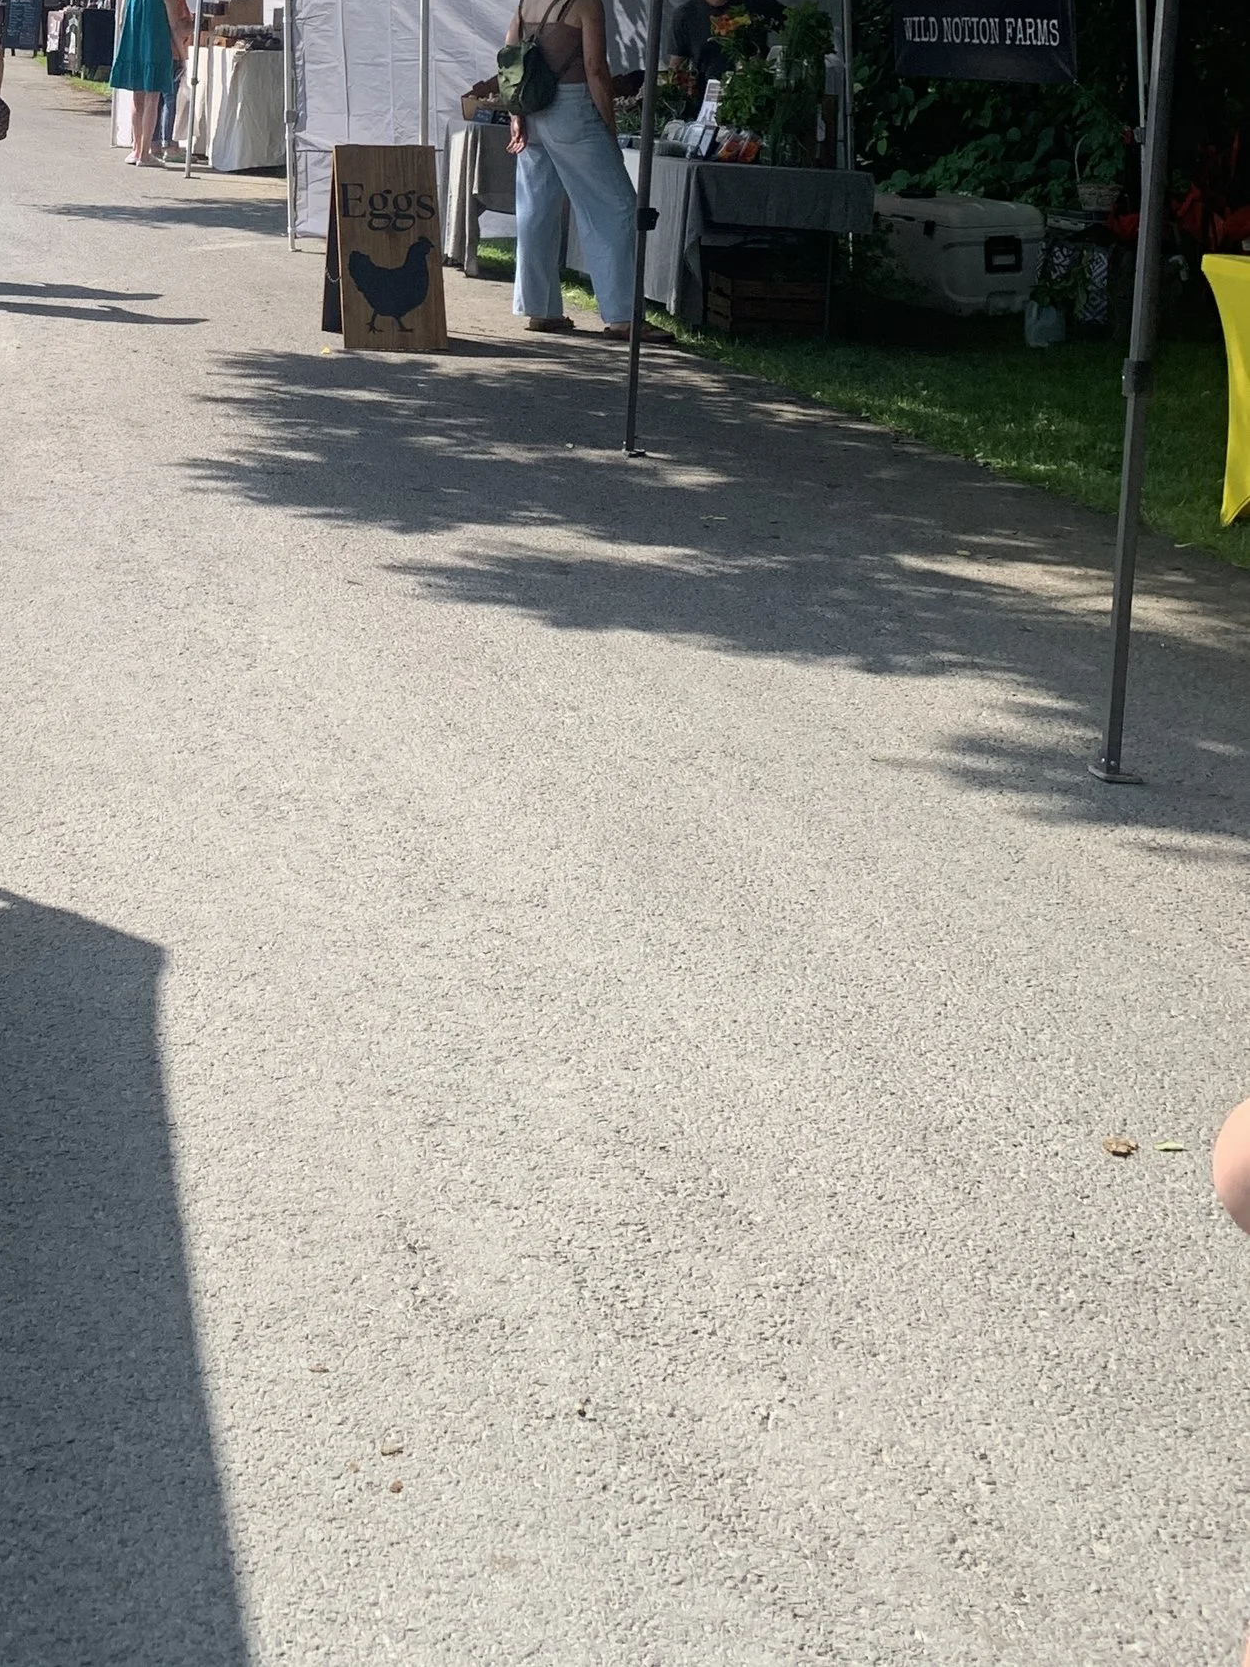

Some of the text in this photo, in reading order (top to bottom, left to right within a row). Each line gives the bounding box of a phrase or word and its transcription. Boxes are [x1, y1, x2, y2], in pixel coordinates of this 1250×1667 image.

[903, 17, 1060, 46] WILD NOTION FARMS
[341, 183, 436, 231] Eggs
